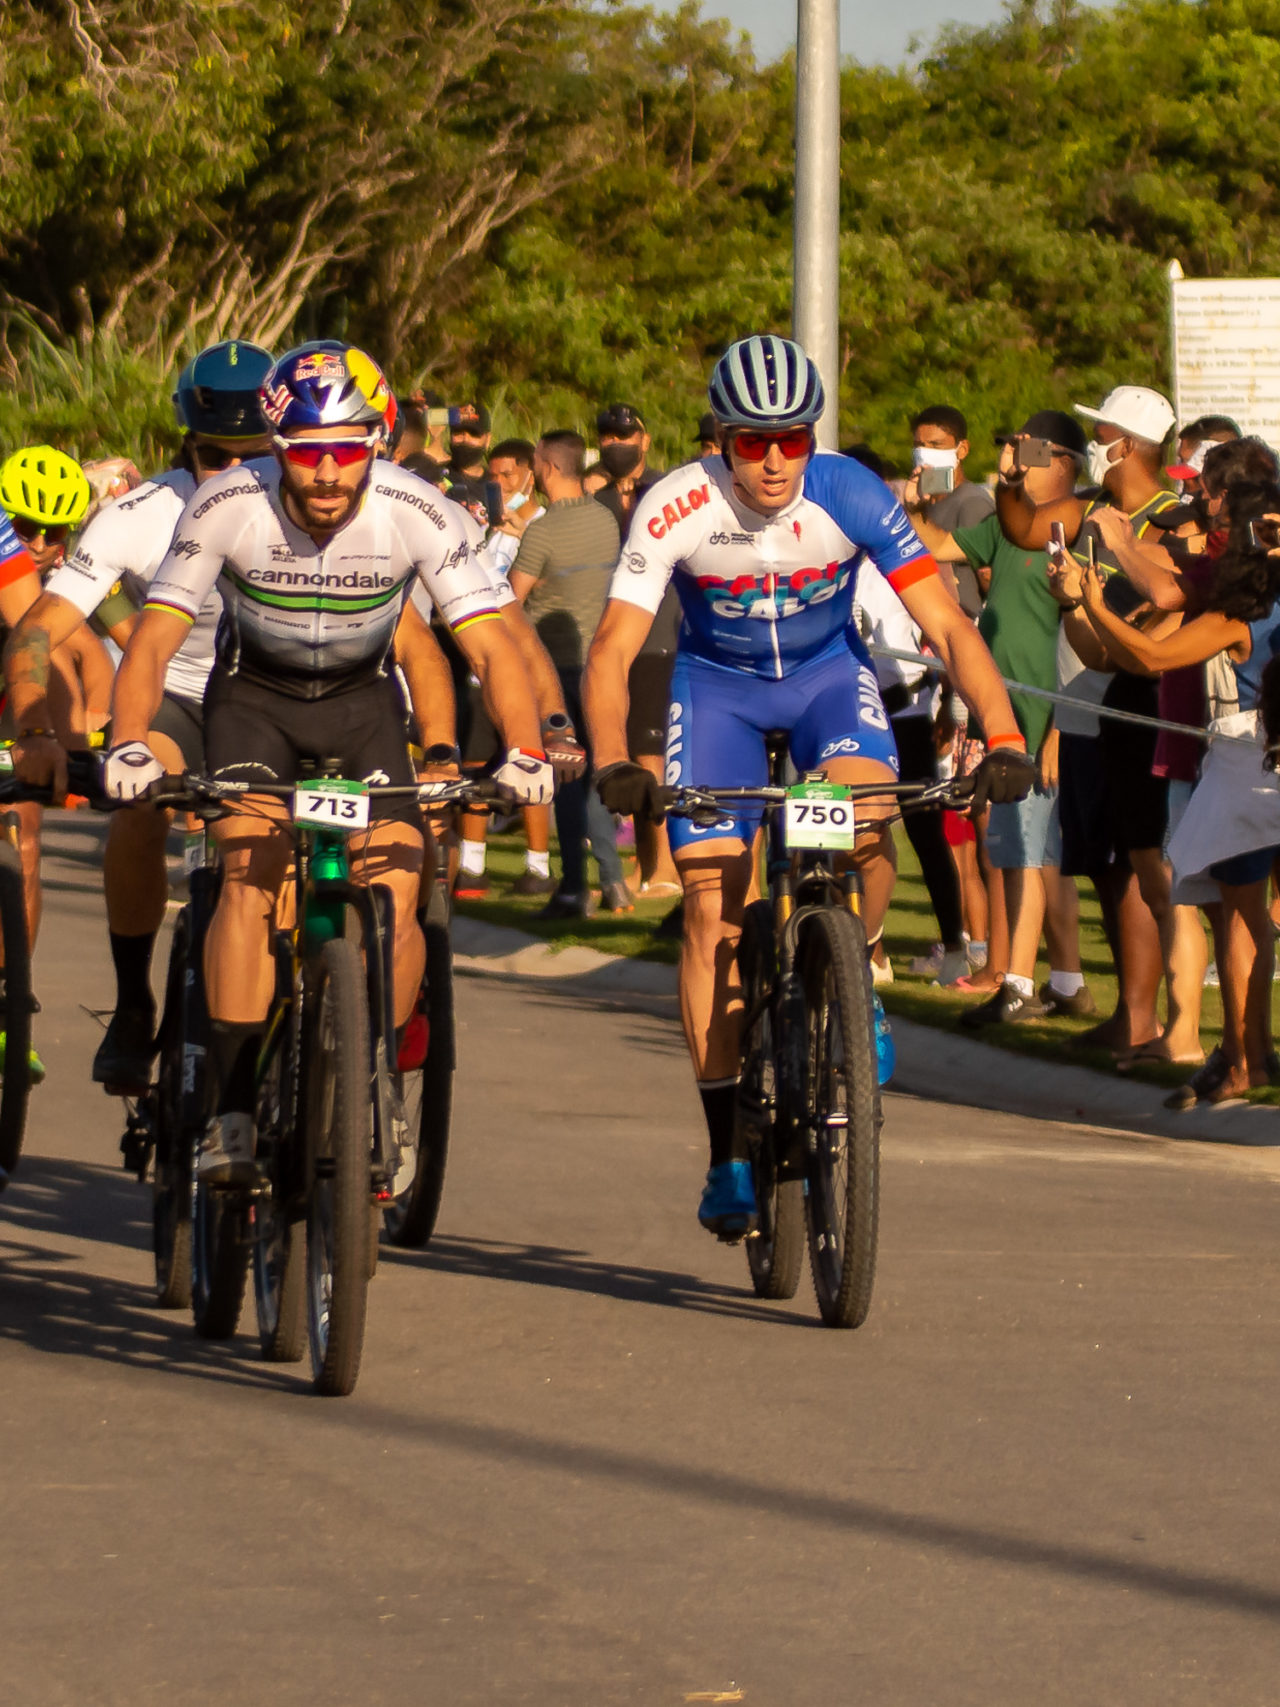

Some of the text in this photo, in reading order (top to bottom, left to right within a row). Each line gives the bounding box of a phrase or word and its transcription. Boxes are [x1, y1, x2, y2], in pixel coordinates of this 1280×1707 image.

[295, 364, 345, 382] Red Bull
[193, 483, 270, 519] cannondale
[375, 484, 447, 530] cannondale
[647, 483, 711, 540] CALOI
[435, 538, 470, 576] Lefty
[246, 568, 395, 588] cannondale
[664, 702, 683, 788] CALO
[307, 795, 359, 820] 713
[793, 804, 848, 826] 750
